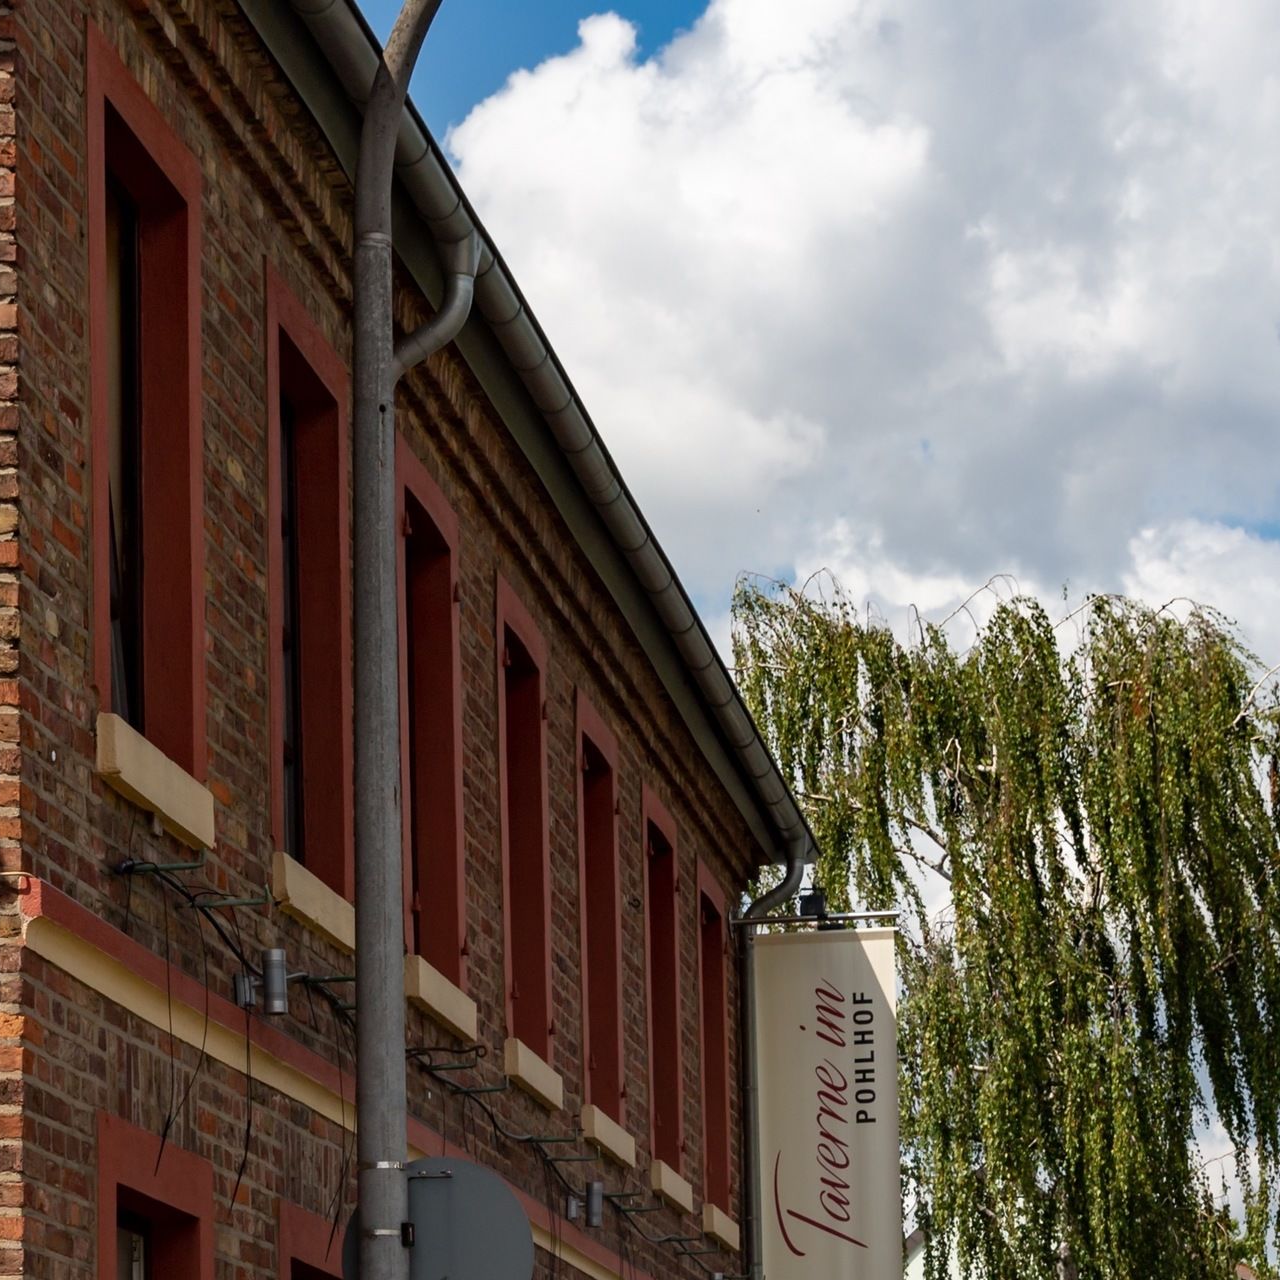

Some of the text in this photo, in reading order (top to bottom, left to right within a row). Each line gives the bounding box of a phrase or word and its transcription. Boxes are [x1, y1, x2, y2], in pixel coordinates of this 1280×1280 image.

[774, 977, 869, 1257] Taverne im
[852, 992, 877, 1125] POHLHOF
